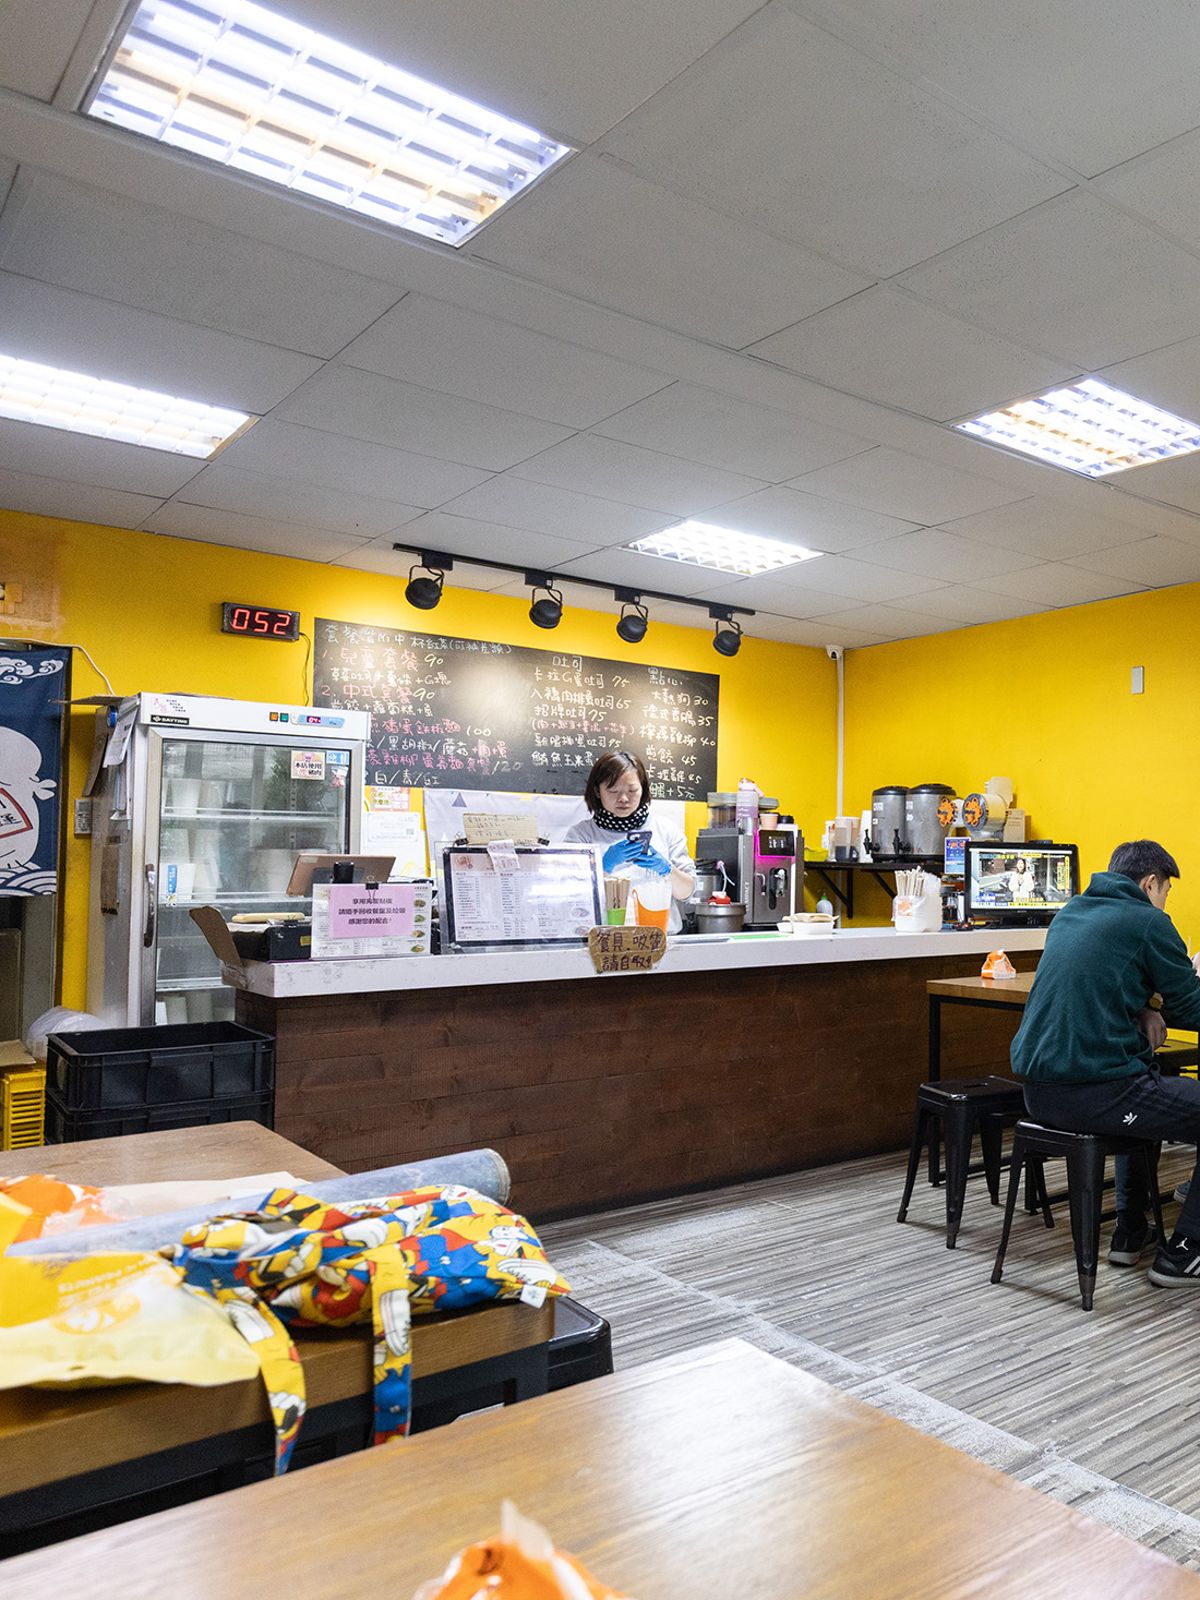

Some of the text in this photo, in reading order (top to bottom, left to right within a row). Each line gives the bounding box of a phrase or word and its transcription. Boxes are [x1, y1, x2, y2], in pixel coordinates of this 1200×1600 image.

[232, 608, 291, 635] 052
[340, 646, 418, 672] 兒童套餐
[424, 653, 444, 667] 90
[553, 655, 583, 673] 吐司
[413, 687, 435, 701] 90
[694, 695, 709, 706] 30
[534, 704, 587, 721] 招牌吐司
[698, 715, 715, 727] 35
[467, 725, 491, 737] 100
[531, 751, 599, 768] 鮪魚玉米蛋
[681, 755, 697, 766] 45
